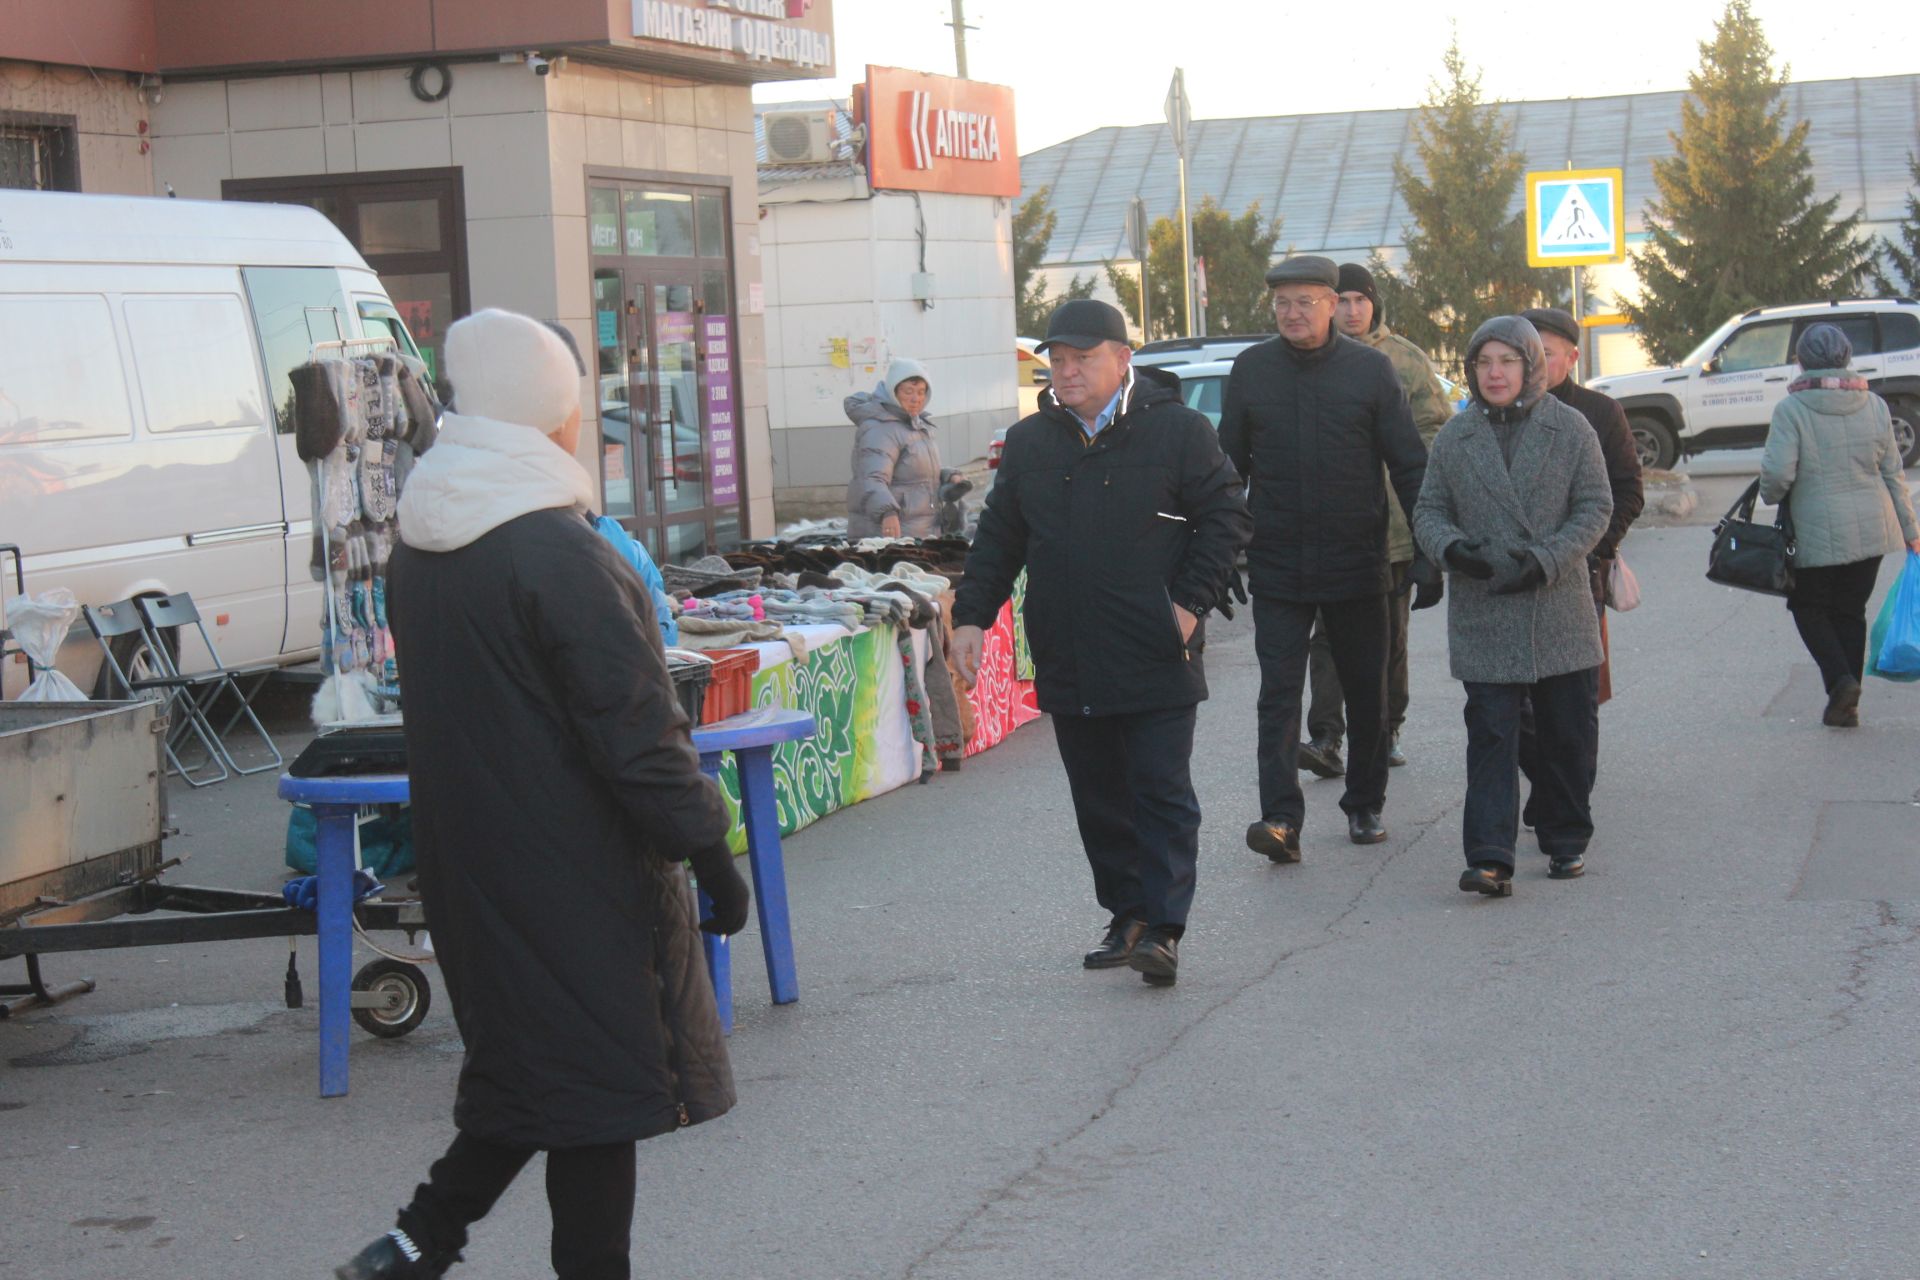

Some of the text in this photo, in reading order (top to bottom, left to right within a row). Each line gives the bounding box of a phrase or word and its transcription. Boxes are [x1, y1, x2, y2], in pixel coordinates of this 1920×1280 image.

[642, 1, 831, 69] МАГАЗИН ОДЕЖДЫ
[936, 108, 1001, 161] АПТЕКА
